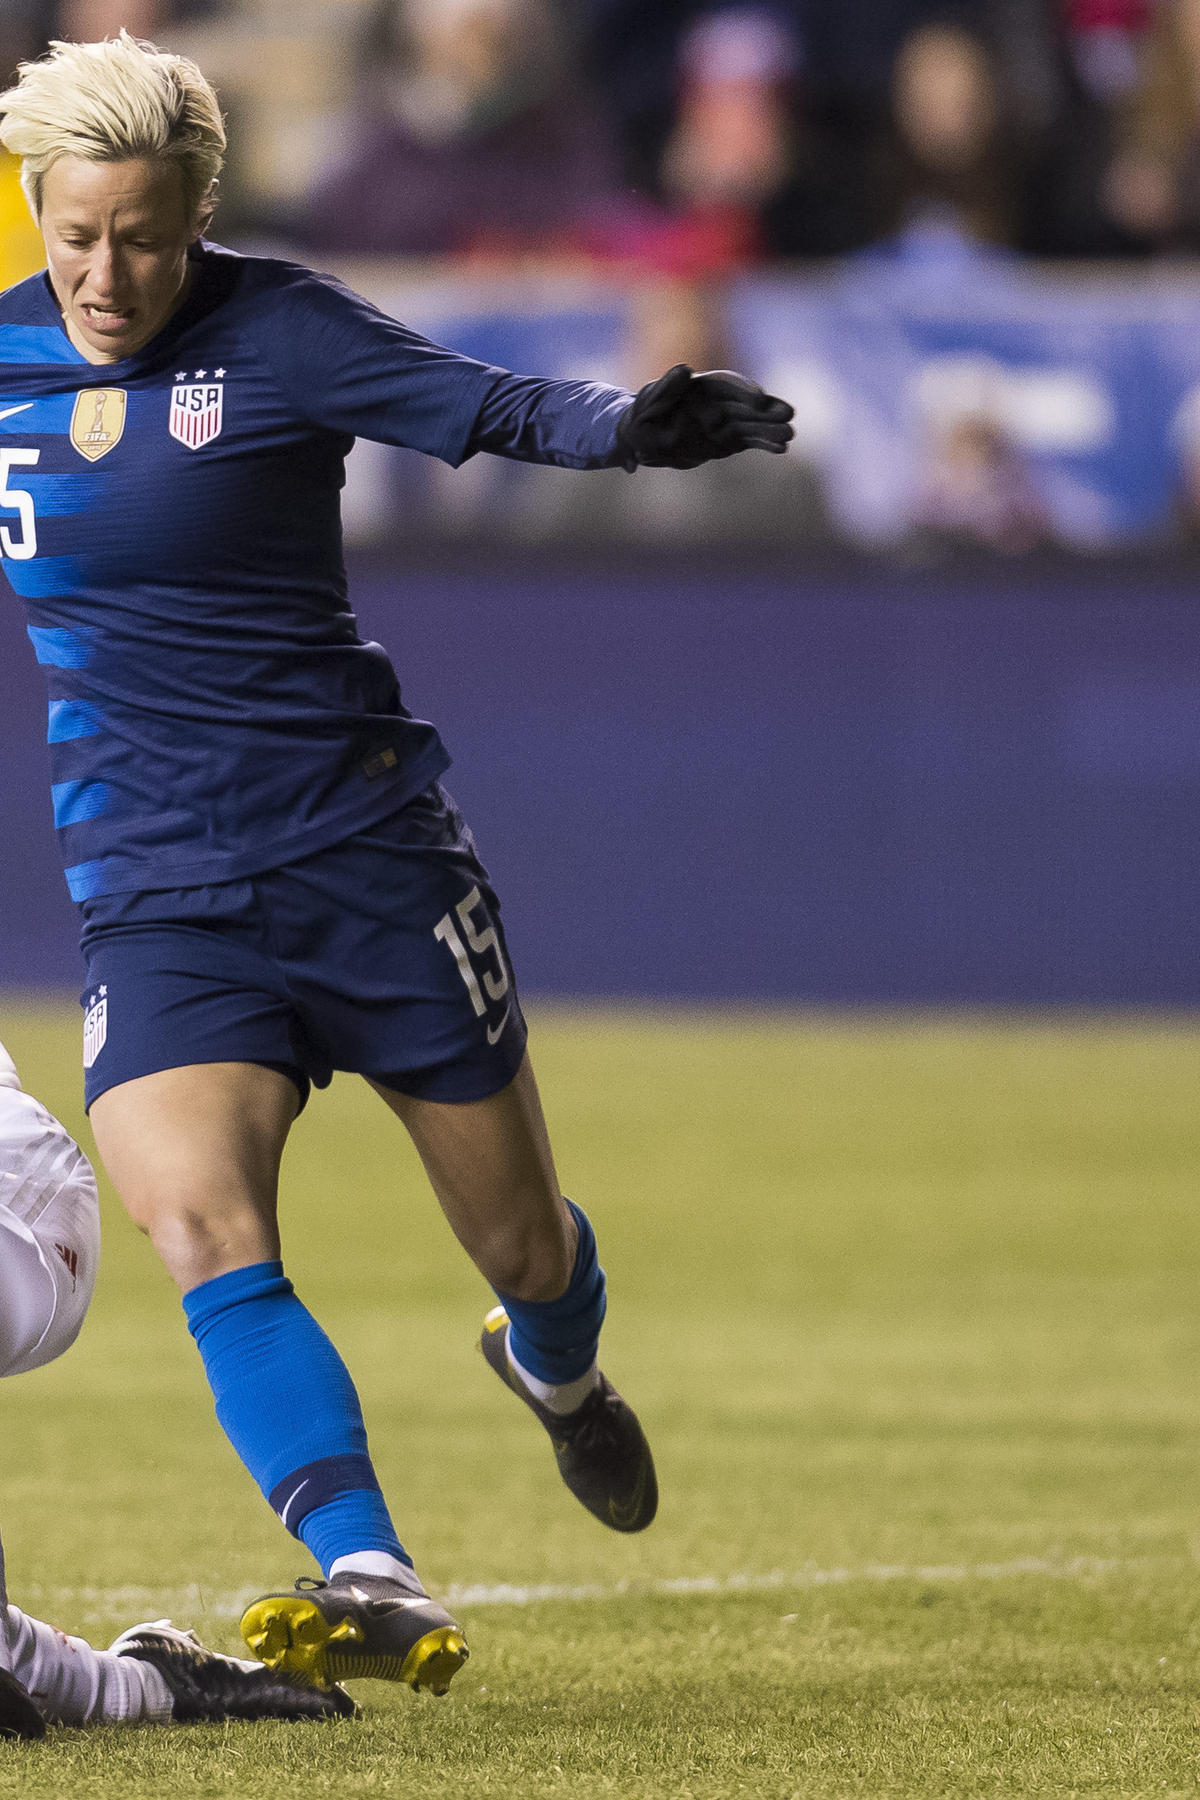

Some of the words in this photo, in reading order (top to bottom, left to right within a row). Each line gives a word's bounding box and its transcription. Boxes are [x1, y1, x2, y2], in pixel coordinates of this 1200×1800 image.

[175, 388, 219, 412] USA
[84, 432, 108, 441] FIFA
[433, 885, 509, 1018] 15
